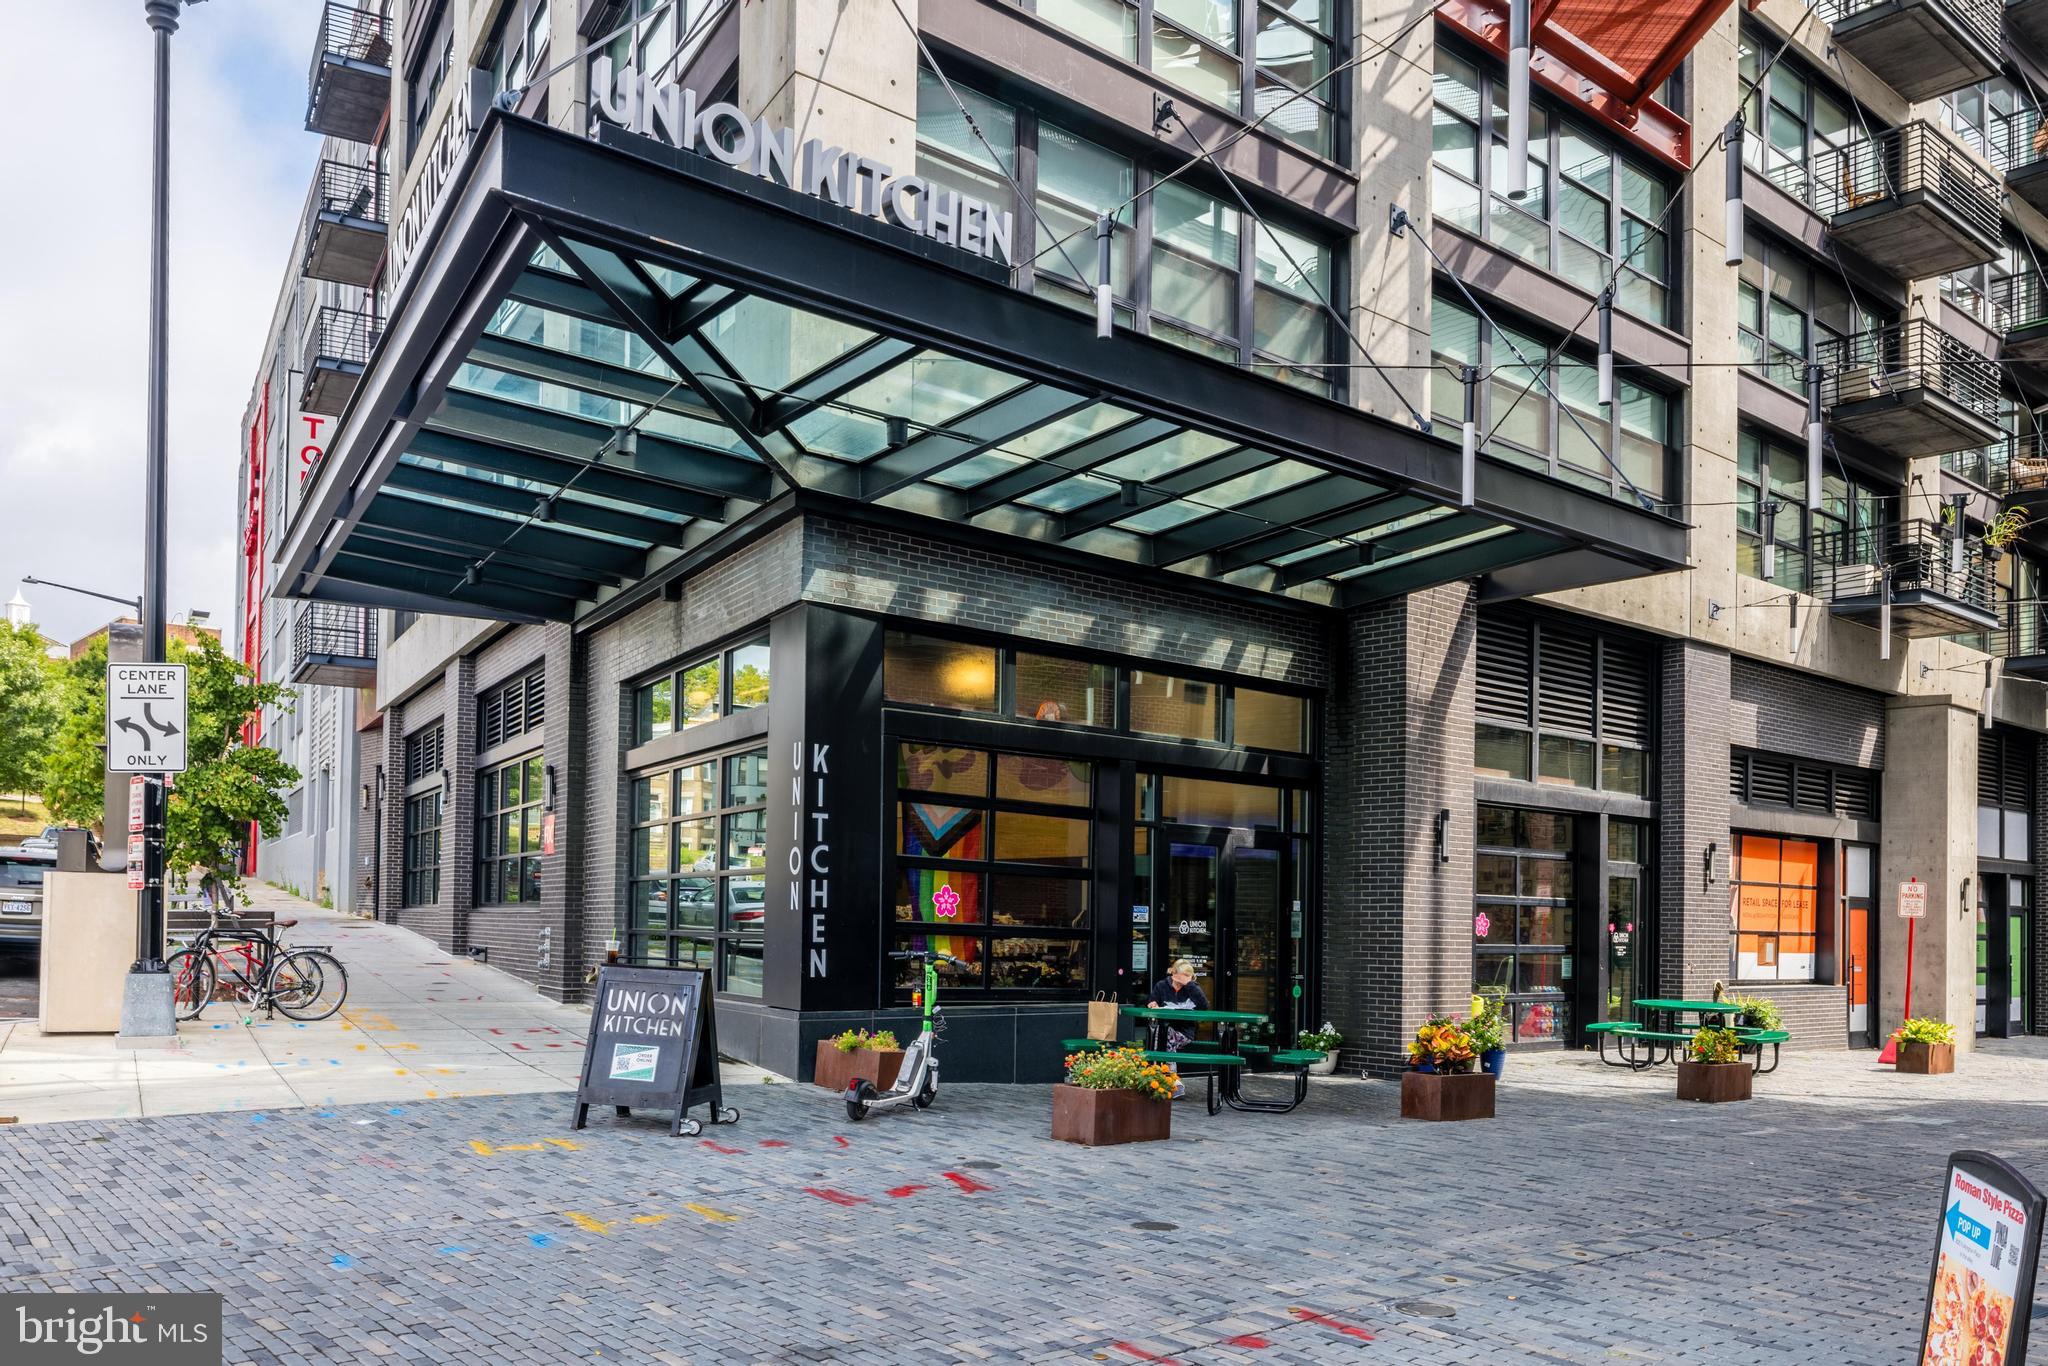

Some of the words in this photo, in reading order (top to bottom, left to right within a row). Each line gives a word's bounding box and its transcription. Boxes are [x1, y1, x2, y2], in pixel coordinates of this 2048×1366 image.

[592, 56, 793, 186] UNION
[802, 138, 1012, 263] KITCHEN
[389, 185, 420, 290] UNION
[420, 82, 473, 225] KITCHEN
[301, 416, 324, 484] TO
[118, 670, 176, 681] CENTER
[127, 684, 167, 695] LANE
[127, 755, 167, 766] ONLY
[789, 742, 802, 911] UNION
[810, 743, 832, 978] KITCHEN
[1742, 897, 1761, 907] RETAIL
[1762, 898, 1778, 908] SPACE
[1781, 899, 1792, 908] FOR
[1793, 900, 1809, 909] LEASE
[607, 989, 689, 1016] UNION
[603, 1015, 684, 1037] KITCHEN
[1954, 1173, 1982, 1201] Roman
[1983, 1188, 2003, 1212] Style
[2003, 1200, 2025, 1225] Pizza
[1957, 1217, 1971, 1234] POP
[1971, 1224, 1982, 1240] UP
